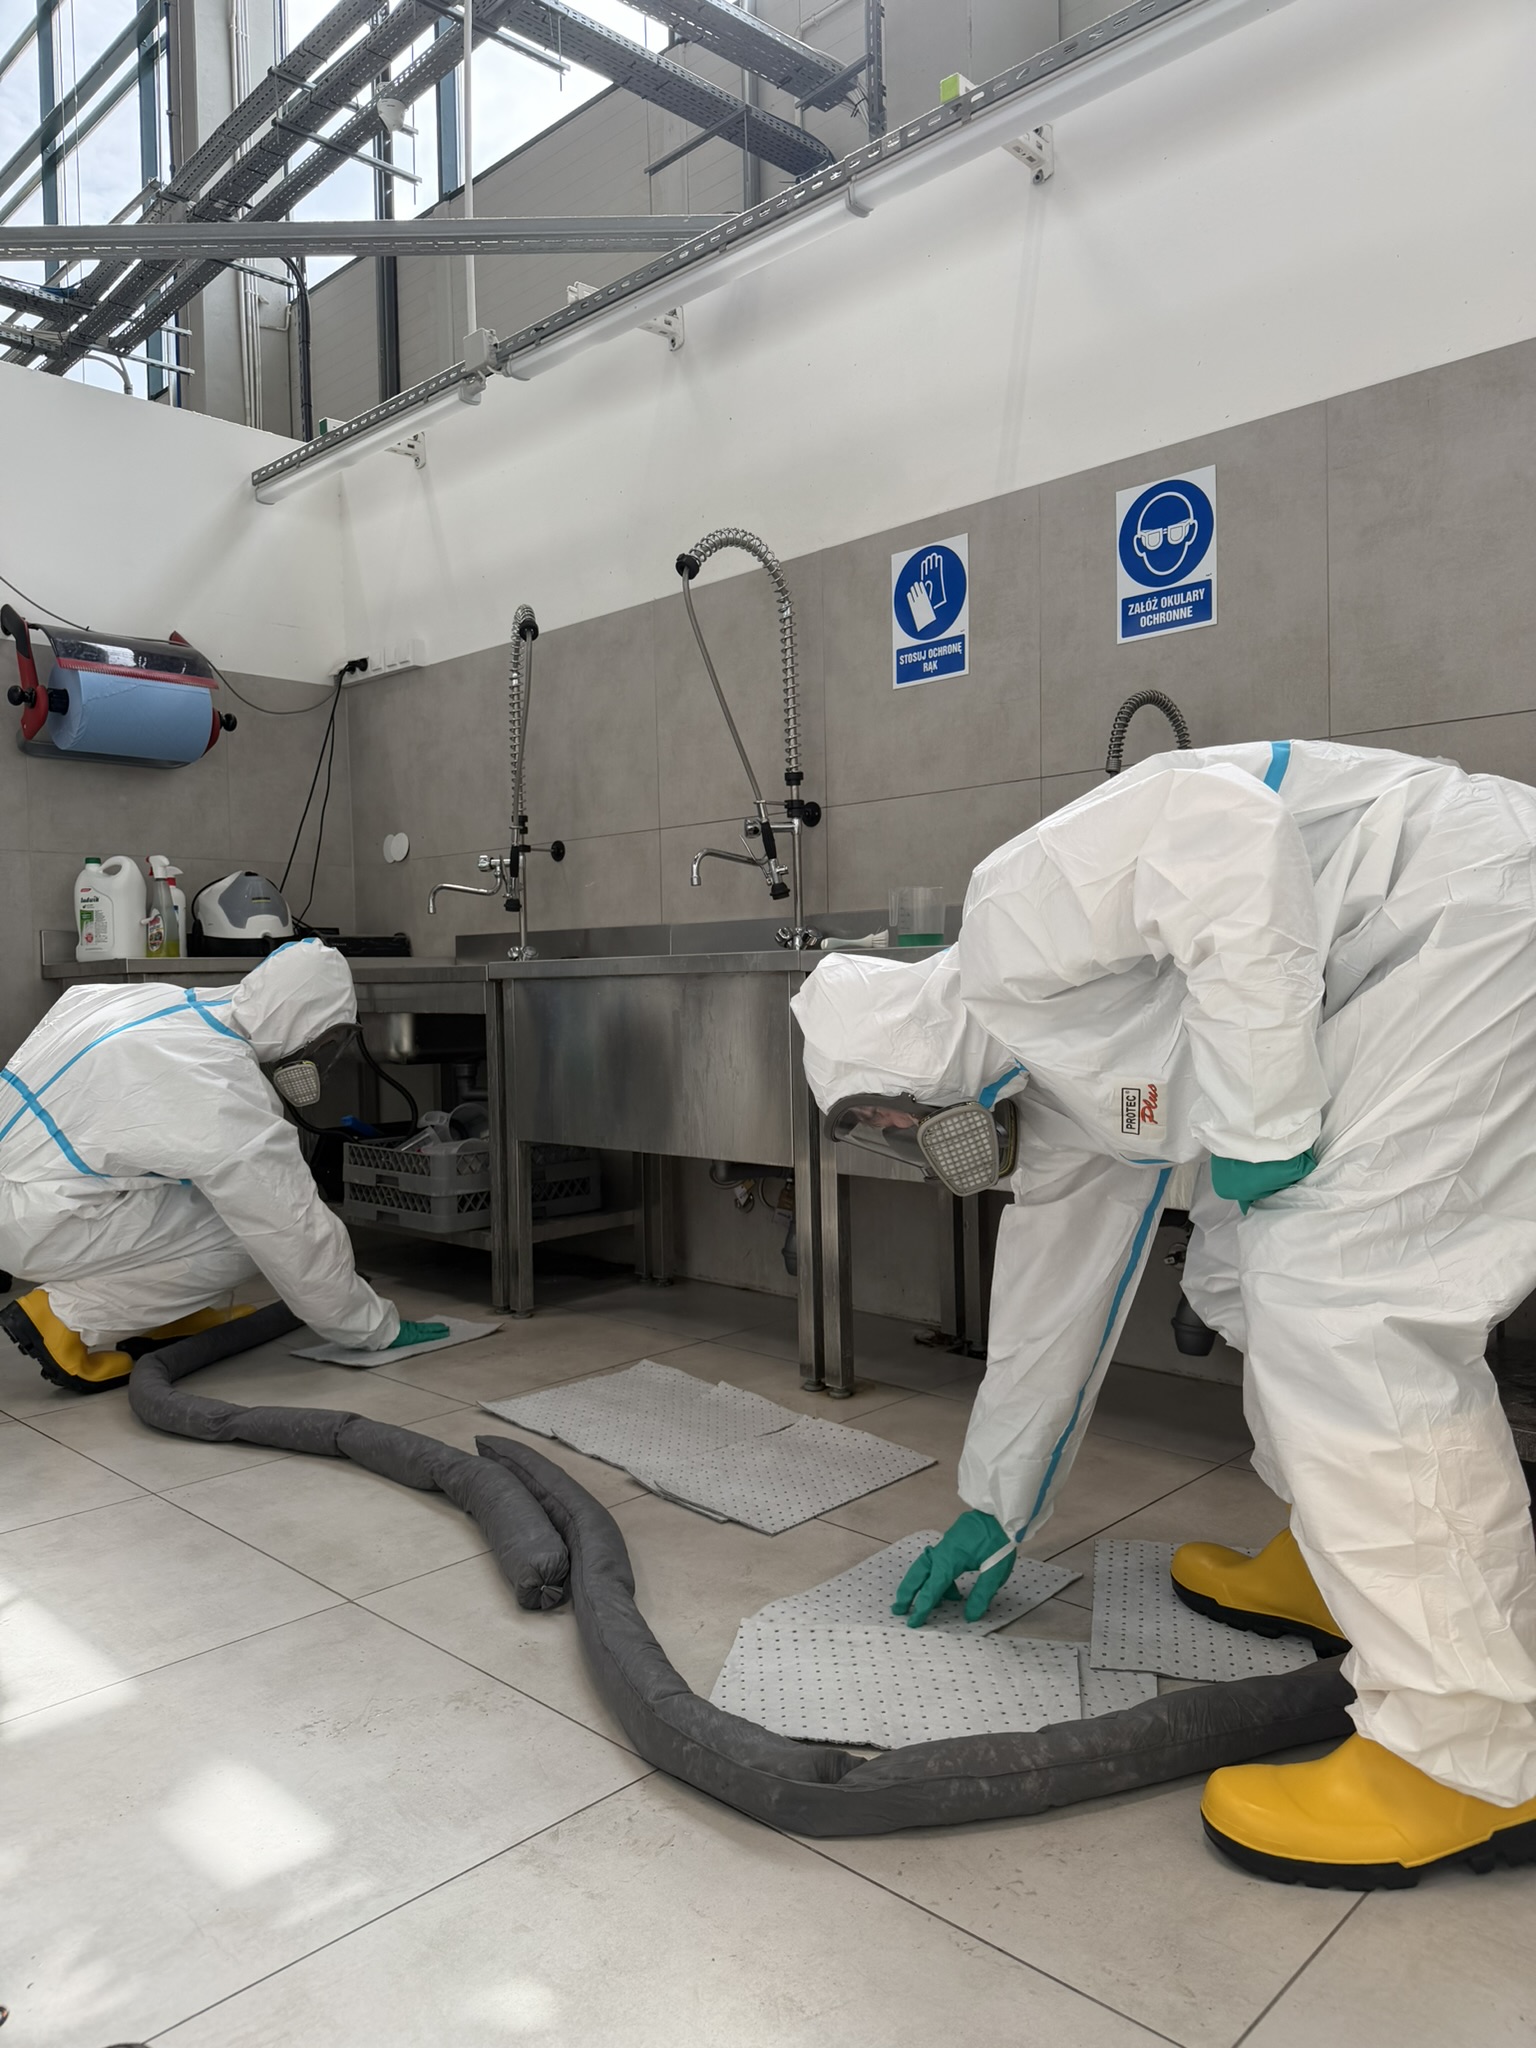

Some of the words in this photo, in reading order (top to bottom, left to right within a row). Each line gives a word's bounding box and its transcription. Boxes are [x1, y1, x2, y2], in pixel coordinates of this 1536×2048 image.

[1128, 596, 1158, 616] ZAŁÓŻ
[1160, 588, 1206, 609] OKULARY
[1140, 605, 1193, 628] OCHRONNE
[899, 649, 927, 666] STOSUJ
[927, 641, 963, 660] OCHRONĘ
[922, 660, 938, 673] RĄK
[1140, 1083, 1158, 1125] Plus
